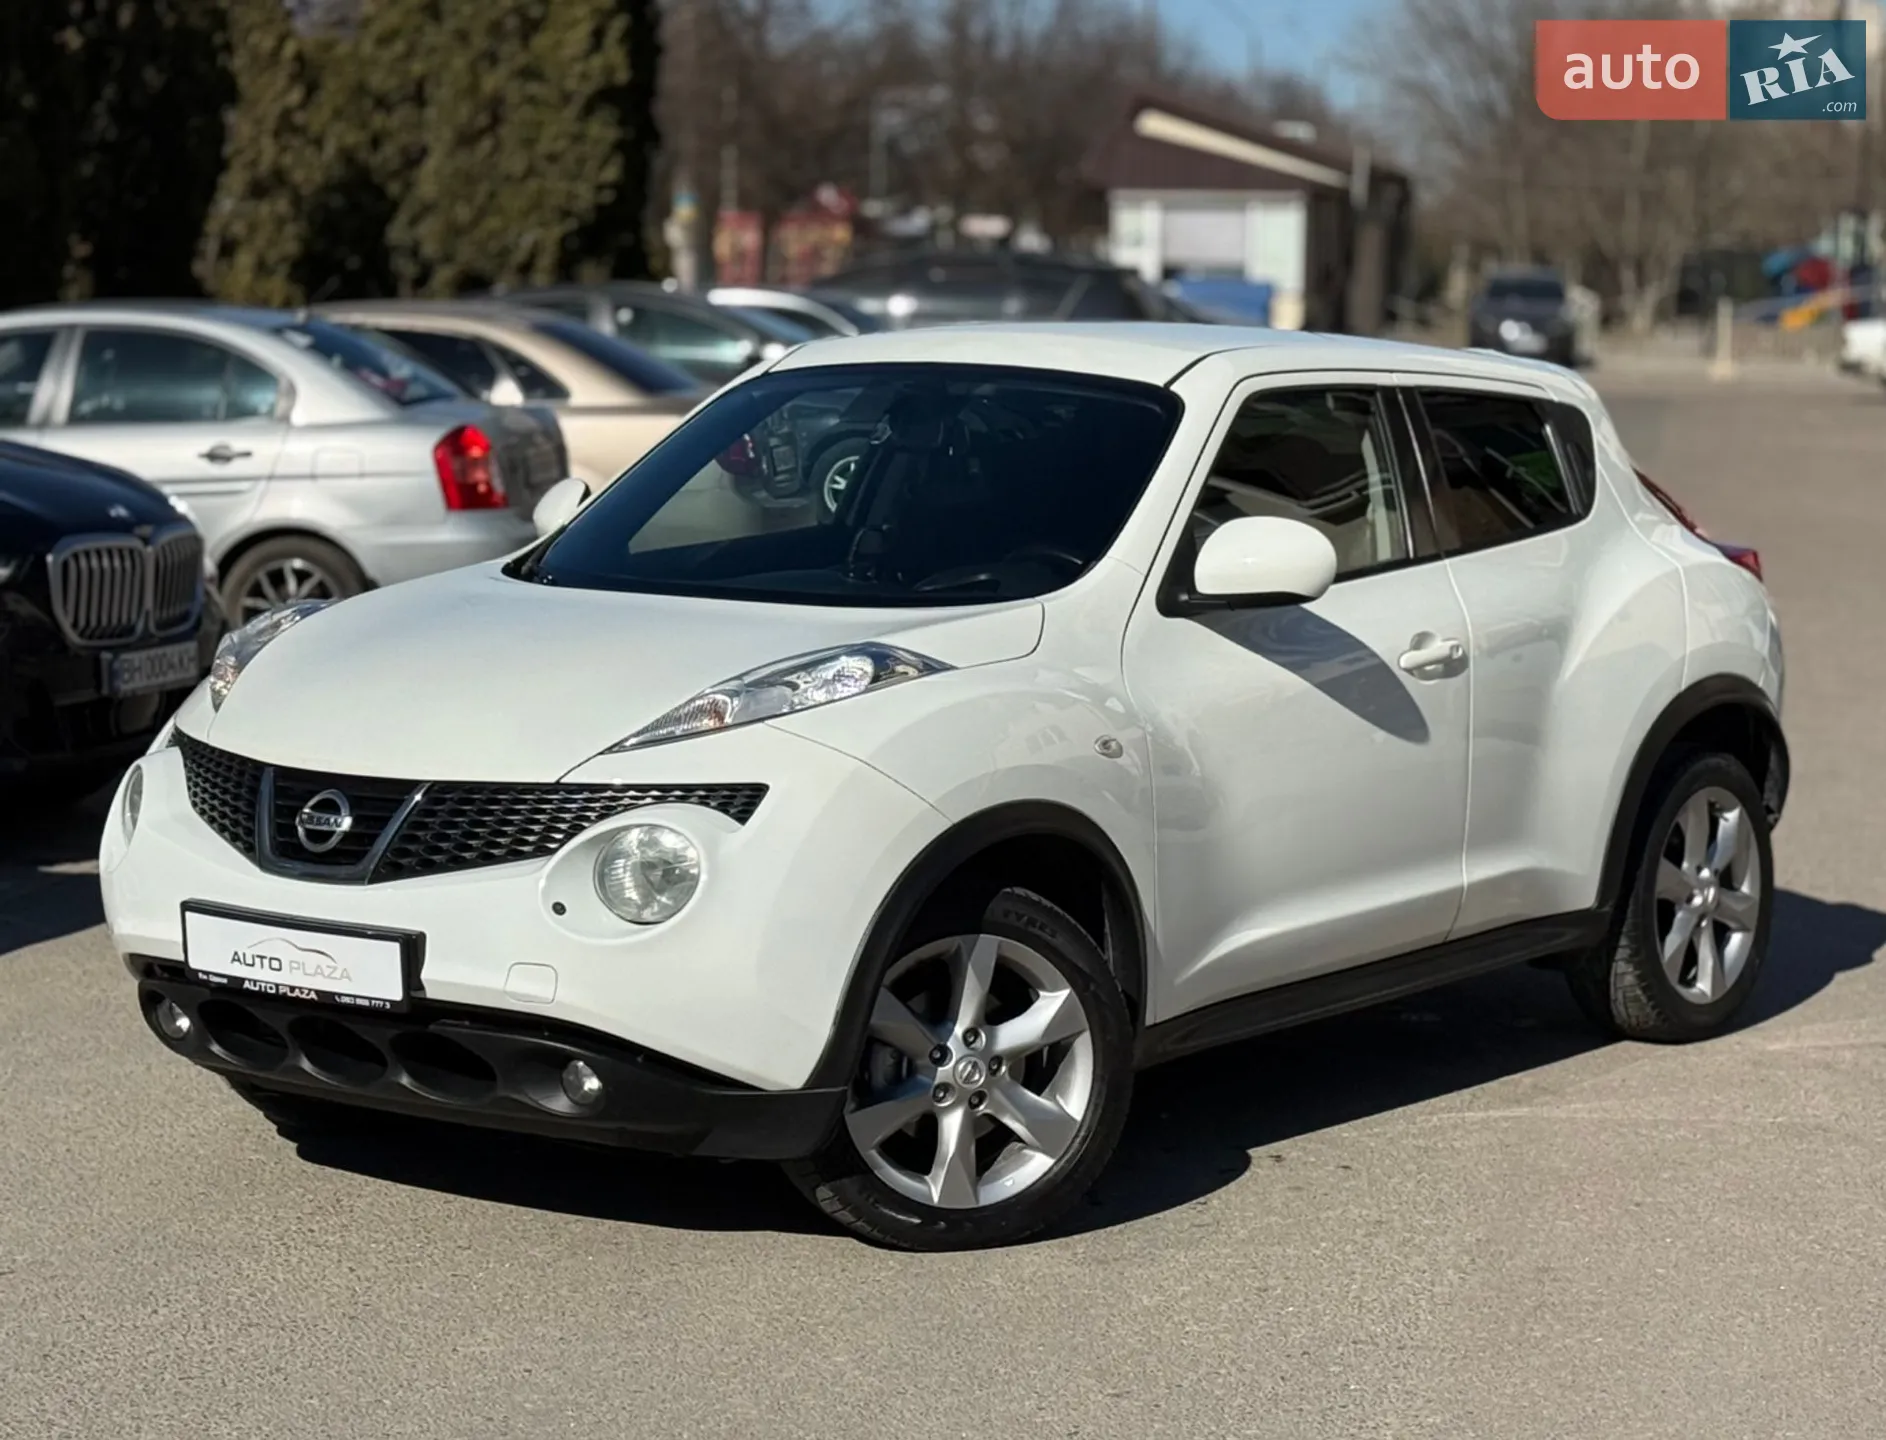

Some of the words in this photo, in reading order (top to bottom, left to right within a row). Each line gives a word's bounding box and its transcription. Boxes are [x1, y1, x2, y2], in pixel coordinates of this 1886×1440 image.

[229, 951, 283, 972] AUTO
[288, 960, 353, 982] PLAZA
[243, 979, 276, 994] AUTO
[278, 985, 318, 1001] PLAZA
